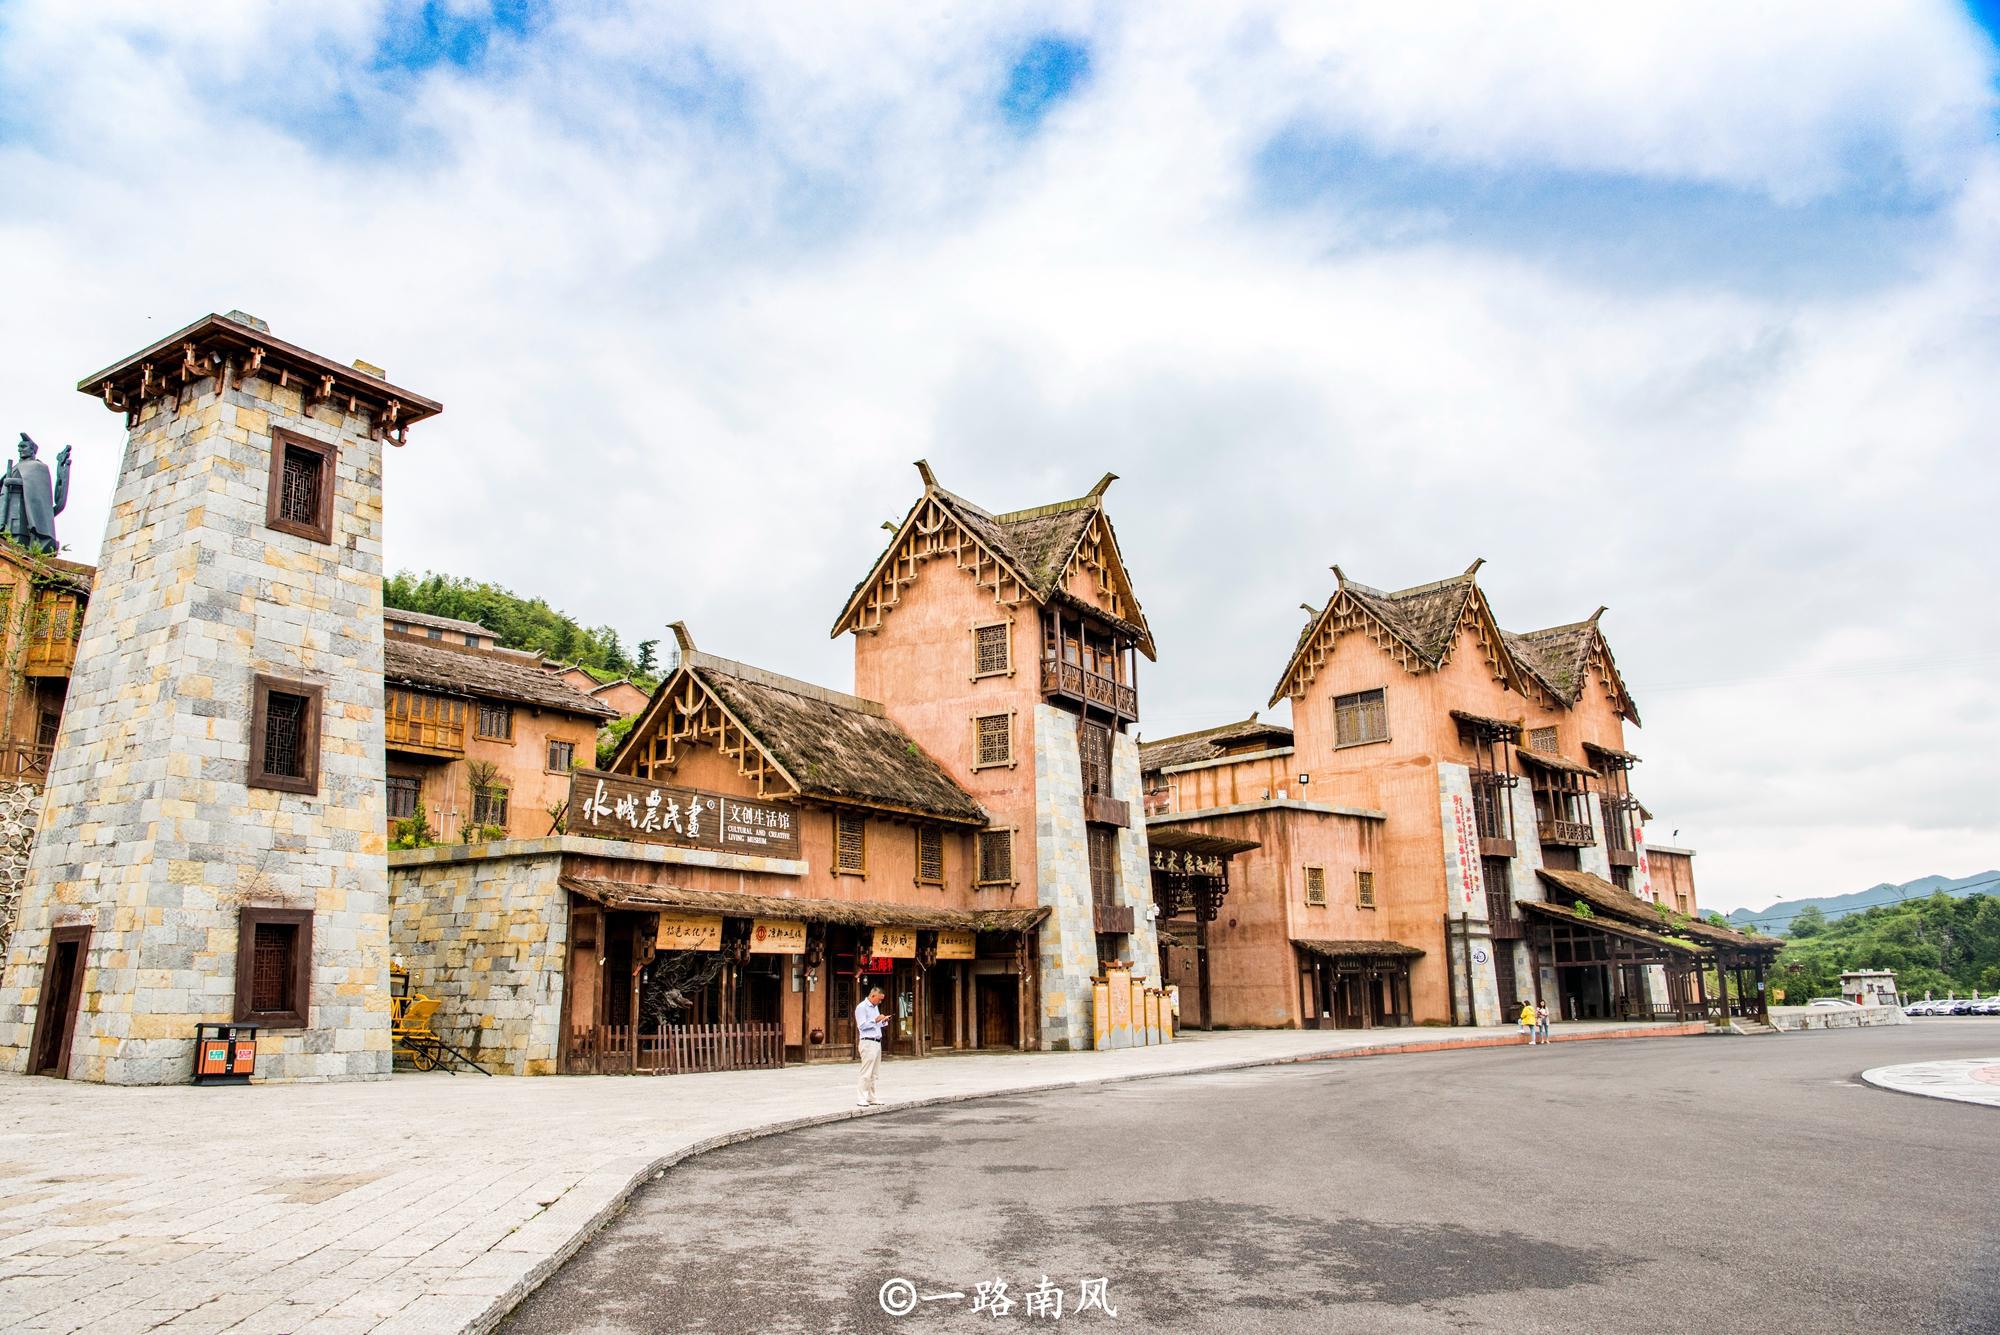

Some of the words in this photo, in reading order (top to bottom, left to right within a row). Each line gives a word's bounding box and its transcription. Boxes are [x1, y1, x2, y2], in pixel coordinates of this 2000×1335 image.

[728, 804, 790, 830] 文创生活馆
[727, 825, 753, 835] CULTURAL
[755, 829, 766, 837] AND
[768, 830, 790, 840] CREATIVE
[727, 833, 745, 842] LIVING
[746, 836, 767, 844] MUSEUM
